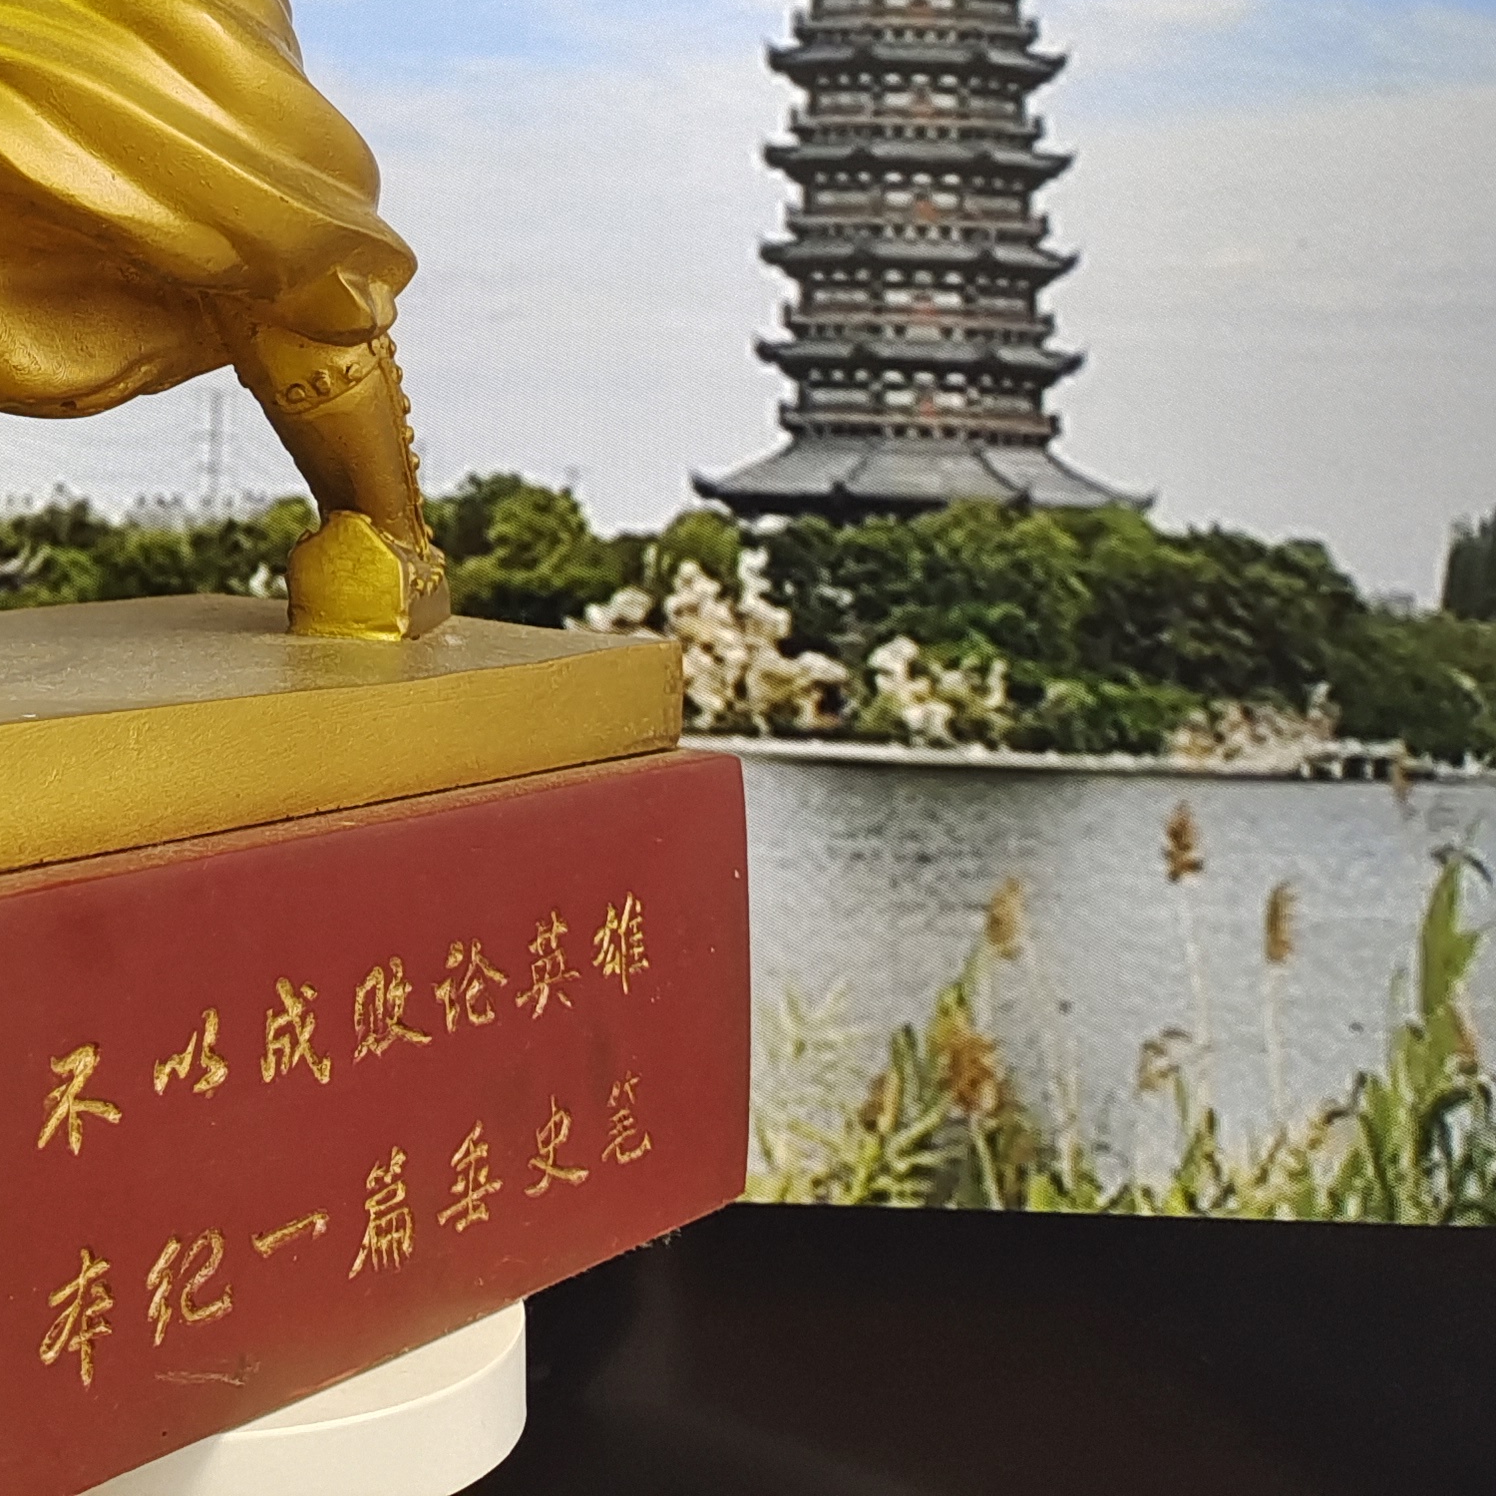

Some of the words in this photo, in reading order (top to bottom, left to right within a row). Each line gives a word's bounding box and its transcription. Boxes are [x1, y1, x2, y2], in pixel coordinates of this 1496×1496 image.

[37, 891, 650, 1155] 不以成败论英雄
[38, 1070, 651, 1387] 本纪一篇垂史笔
